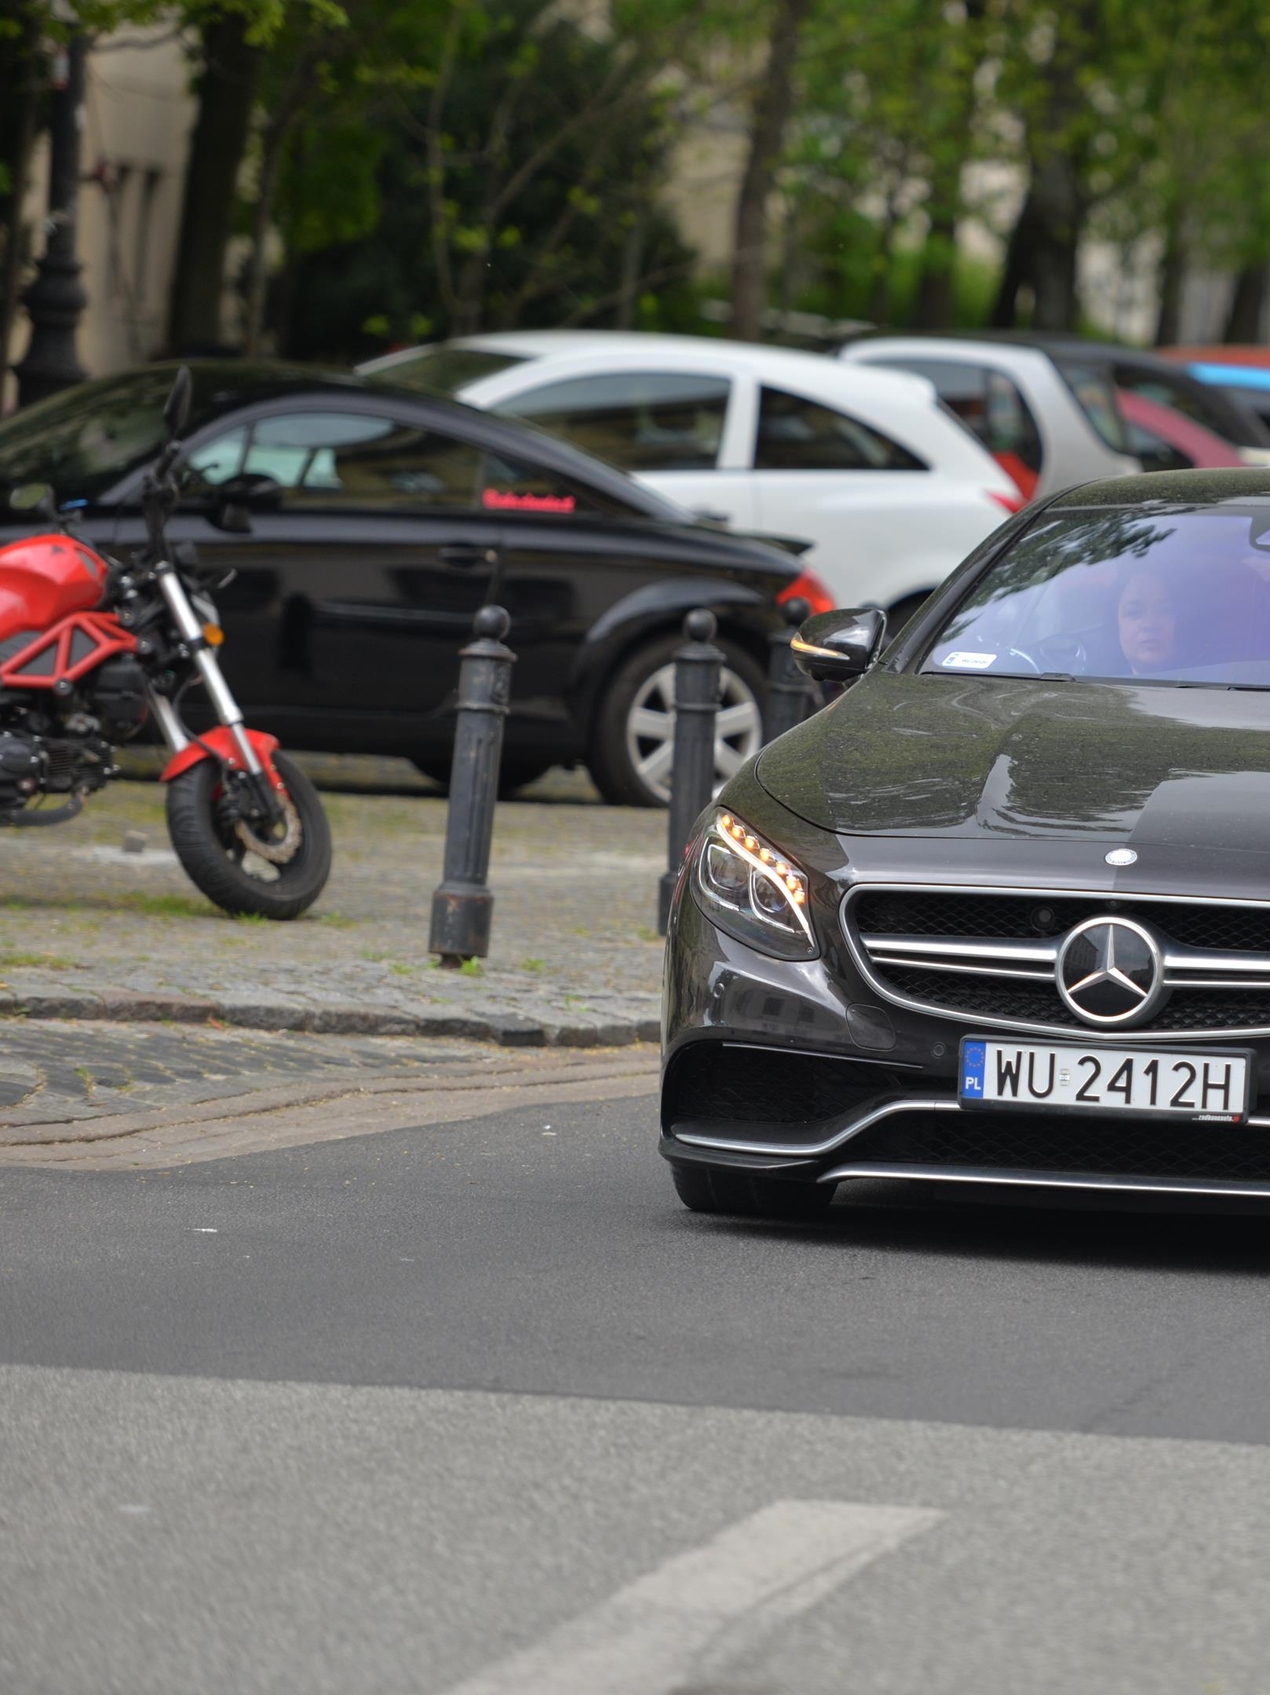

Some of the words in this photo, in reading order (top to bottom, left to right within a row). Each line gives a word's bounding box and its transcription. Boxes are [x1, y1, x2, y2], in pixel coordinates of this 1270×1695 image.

[965, 1076, 982, 1091] PL
[996, 1049, 1056, 1099] WU
[1075, 1054, 1232, 1111] 2412H
